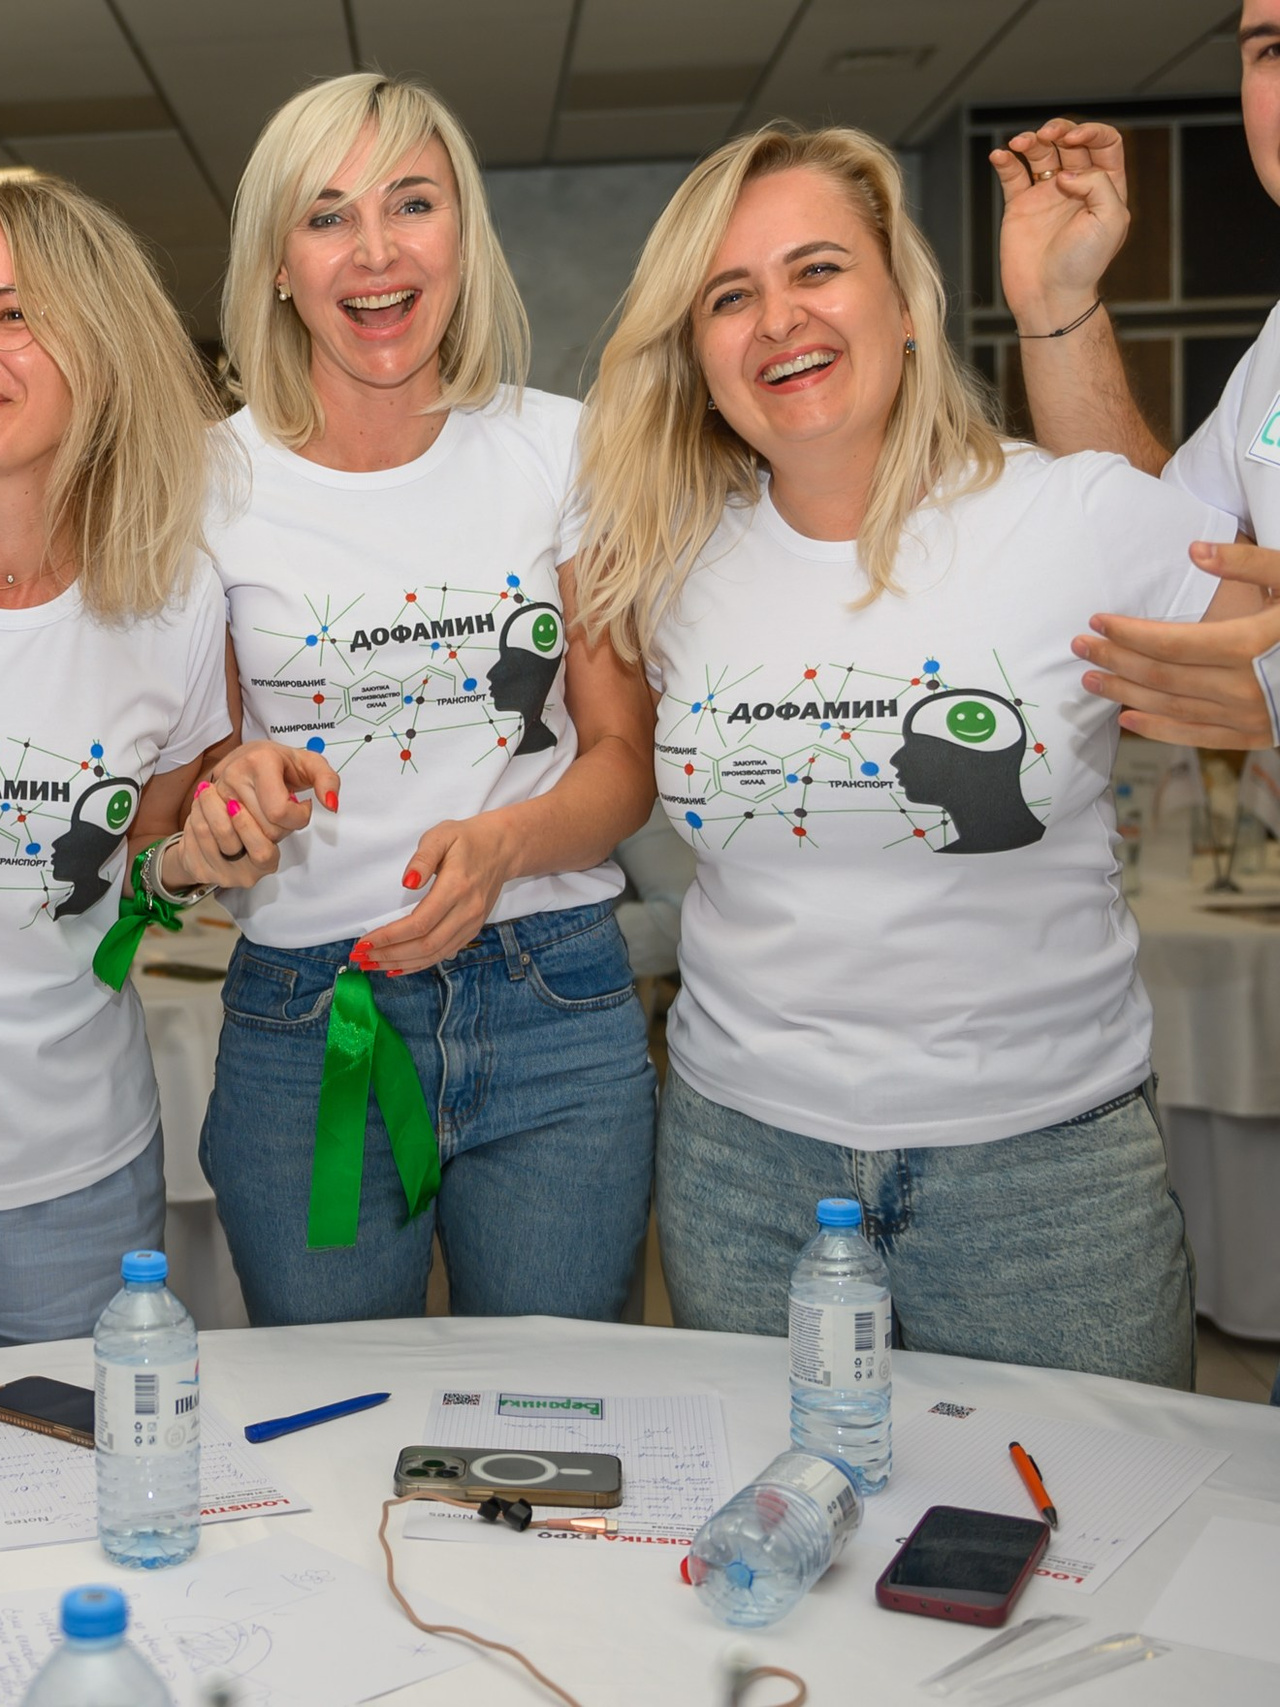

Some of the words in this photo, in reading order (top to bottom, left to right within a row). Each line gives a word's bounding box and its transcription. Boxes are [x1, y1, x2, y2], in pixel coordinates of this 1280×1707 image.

[350, 613, 496, 652] ДОФАМИН
[251, 678, 326, 688] ПРОГНОЗИРОВАНИЕ
[361, 684, 390, 693] ЗАКУПКА
[351, 692, 401, 702] ПРОИЗВОДСТВО
[436, 694, 487, 706] ТРАНСПОРТ
[727, 699, 898, 724] ДОФАМИН
[270, 722, 335, 733] ПЛАНИРОВАНИЕ
[721, 769, 781, 777] ПРОИЗВОДСТВО
[828, 780, 894, 790] ТРАНСПОРТ
[429, 1510, 473, 1520] Notes
[4, 1516, 49, 1526] Notes
[537, 1531, 597, 1541] EXPO
